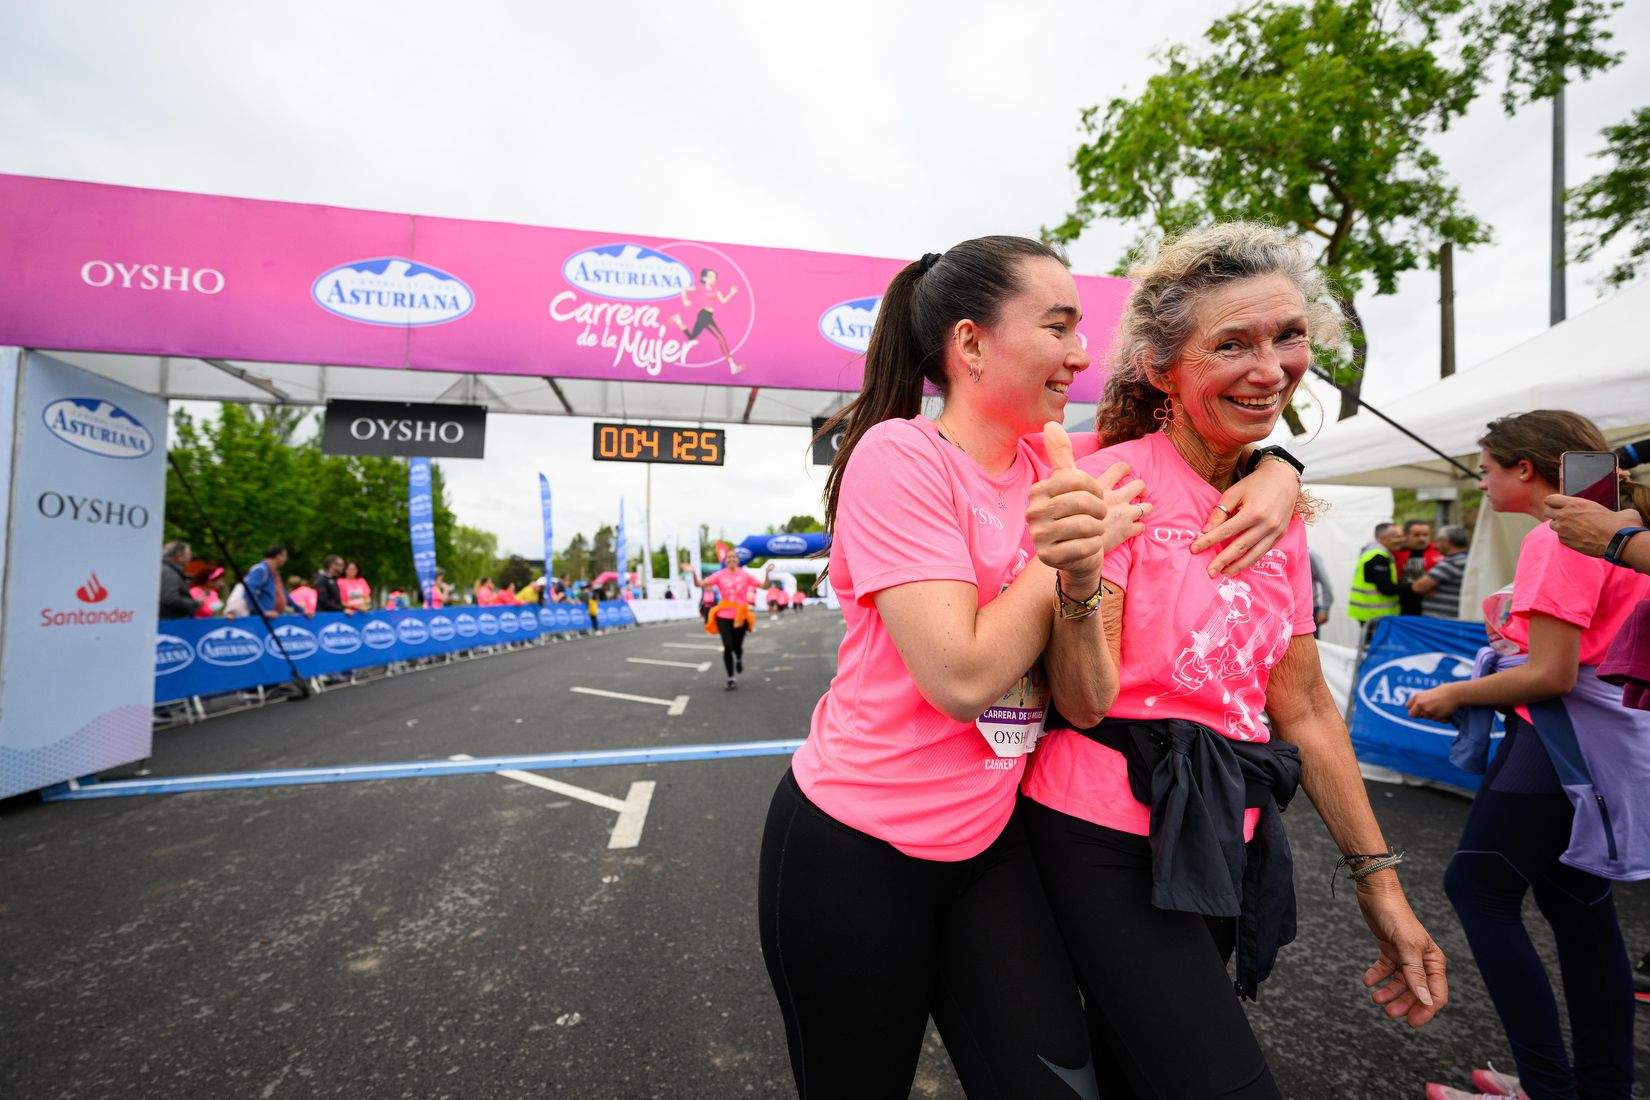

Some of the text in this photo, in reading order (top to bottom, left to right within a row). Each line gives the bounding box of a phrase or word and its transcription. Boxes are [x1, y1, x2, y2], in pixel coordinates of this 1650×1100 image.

[80, 259, 226, 295] OYSHO
[574, 260, 683, 289] ASTURIANA
[327, 279, 461, 311] ASTURIANA
[550, 290, 660, 328] Carrera
[576, 325, 699, 376] de la Mujer
[52, 408, 147, 452] ASTURIANA
[350, 417, 465, 444] OYSHO
[38, 491, 149, 529] OYSHO
[40, 608, 136, 627] Santander
[983, 709, 1017, 720] CARRERA
[1018, 710, 1027, 721] DE
[994, 730, 1028, 745] OYSH
